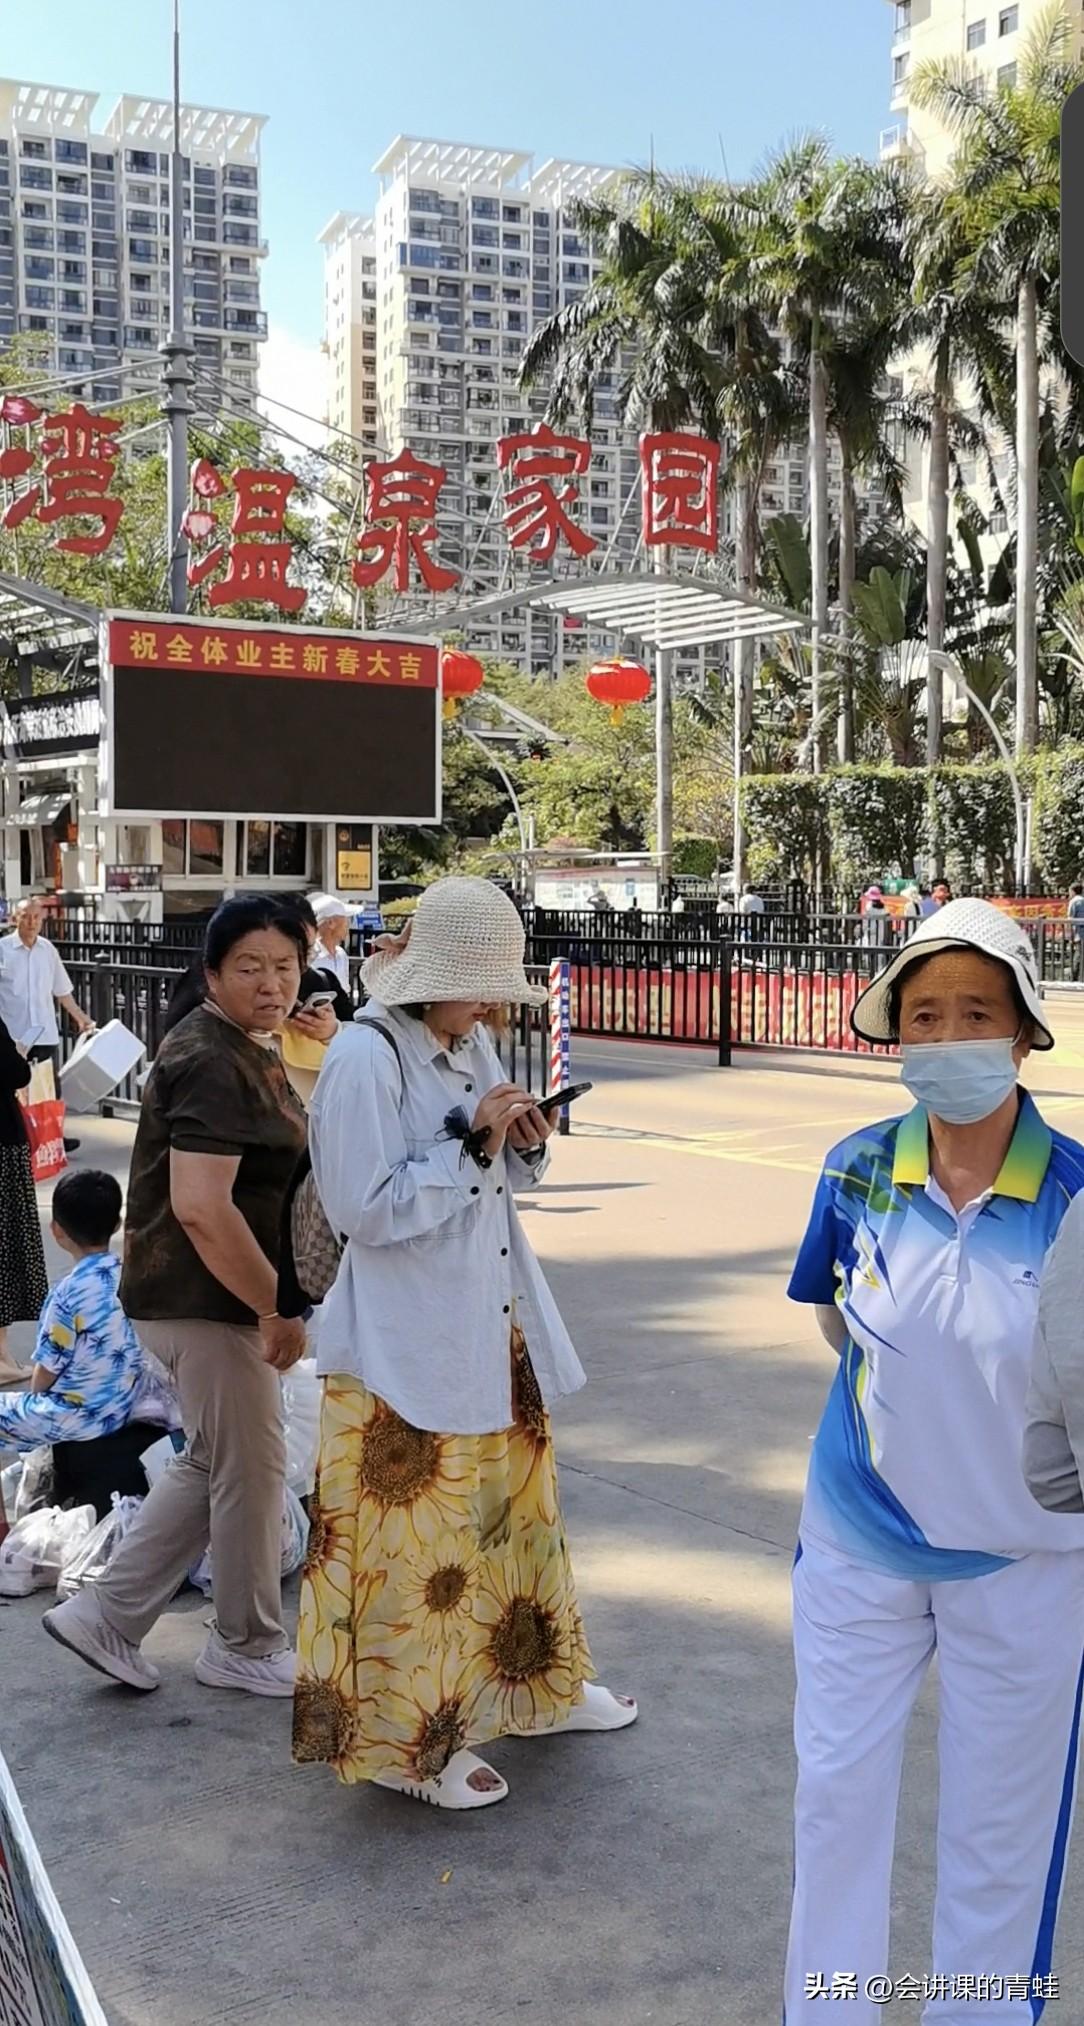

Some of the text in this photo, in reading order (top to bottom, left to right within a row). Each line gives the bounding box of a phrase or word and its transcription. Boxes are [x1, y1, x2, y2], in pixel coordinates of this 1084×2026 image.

[0, 395, 720, 612] 湾温泉家园
[130, 630, 422, 681] 祝全体业主新春大吉
